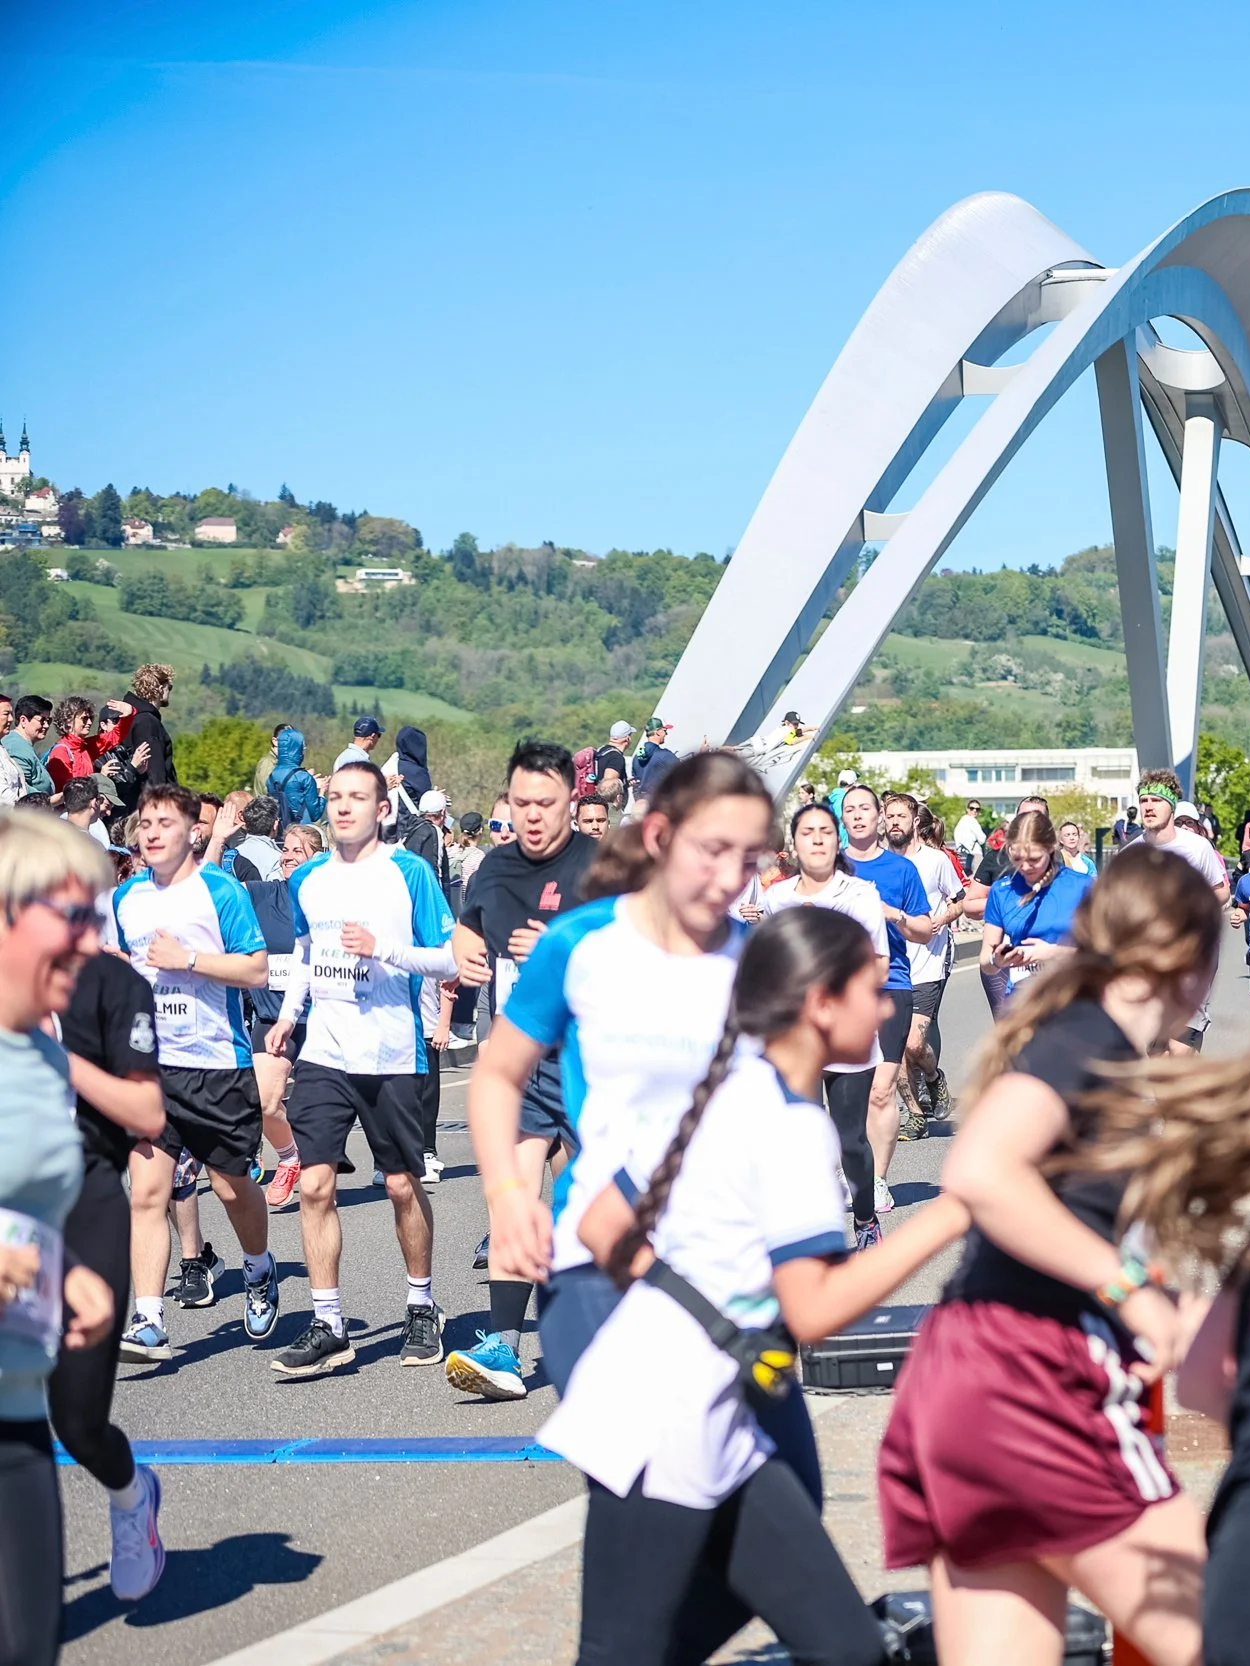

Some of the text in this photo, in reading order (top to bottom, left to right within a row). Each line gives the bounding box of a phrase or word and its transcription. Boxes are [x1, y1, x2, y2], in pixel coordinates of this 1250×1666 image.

[314, 965, 370, 982] DOMINIK
[153, 984, 181, 994] EBA
[154, 1003, 188, 1015] LMIR
